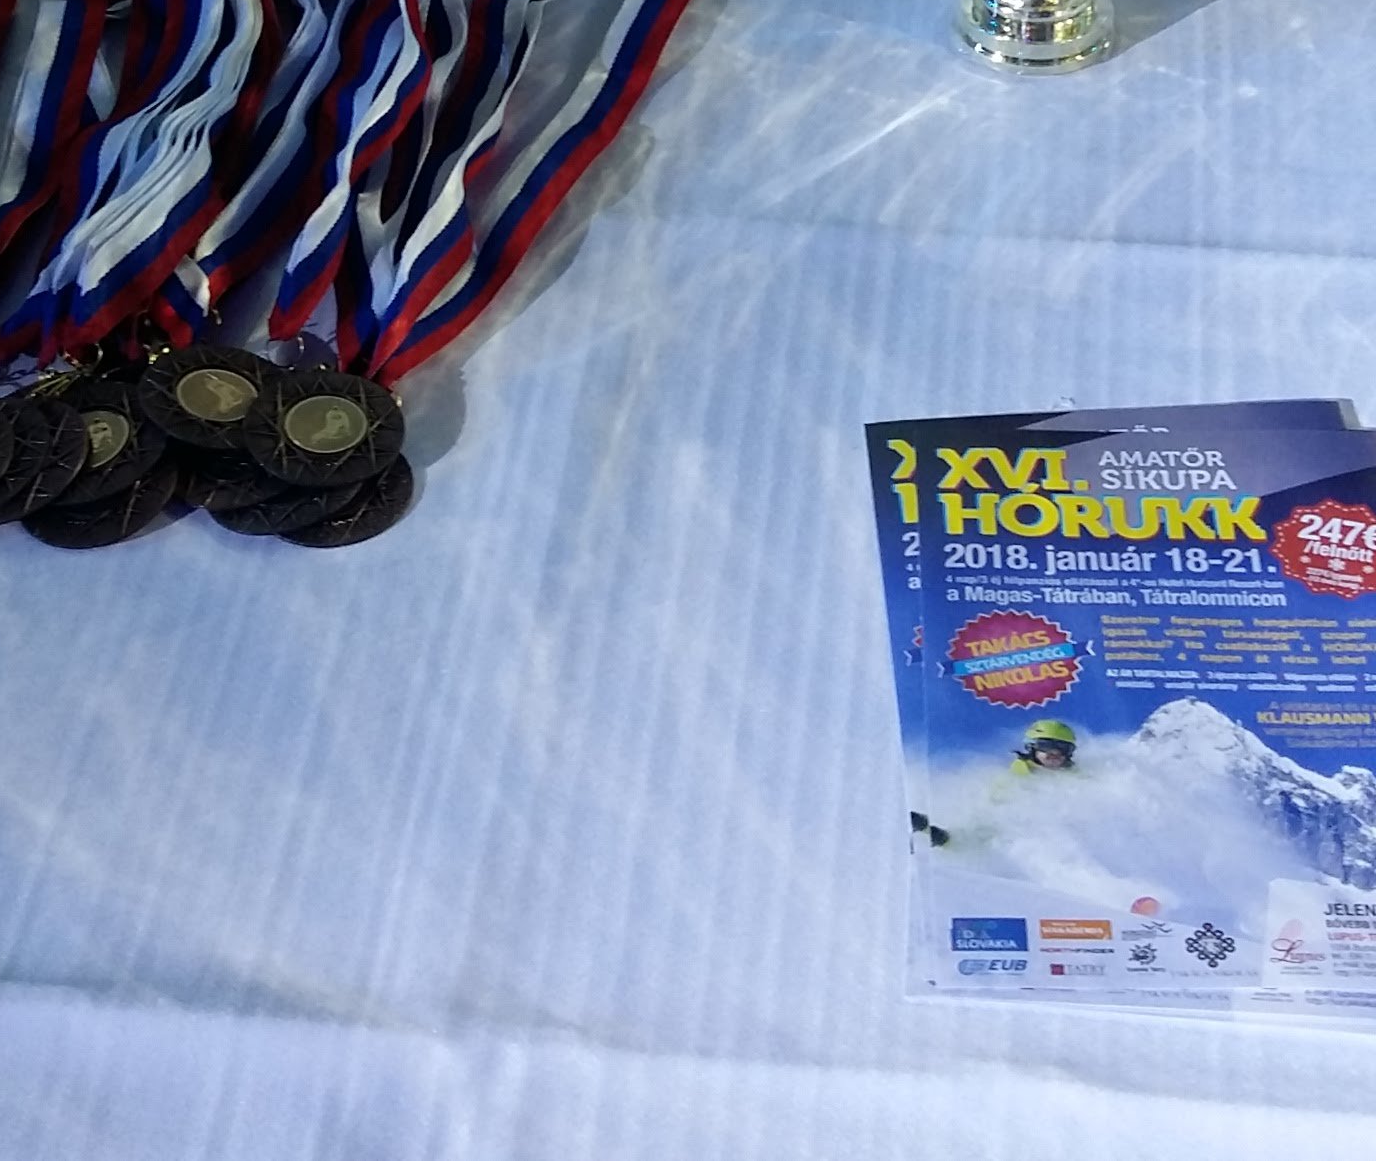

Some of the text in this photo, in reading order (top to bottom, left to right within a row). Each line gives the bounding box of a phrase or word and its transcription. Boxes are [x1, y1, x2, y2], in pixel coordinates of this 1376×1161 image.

[936, 447, 1090, 491] XVI.
[1098, 447, 1225, 467] AMATŐR
[1100, 466, 1238, 490] SÍKUPA
[937, 482, 1267, 540] HÓRUKK
[943, 542, 1038, 570] 2018.
[1044, 545, 1156, 575] január
[1164, 547, 1277, 573] 18-21.
[946, 586, 1287, 606] a Magas-Tátrában, Tátralomnicon
[965, 630, 1052, 657] TAKÁCS
[974, 660, 1070, 691] NIKOLAS
[1256, 711, 1371, 724] KLAUSMANN
